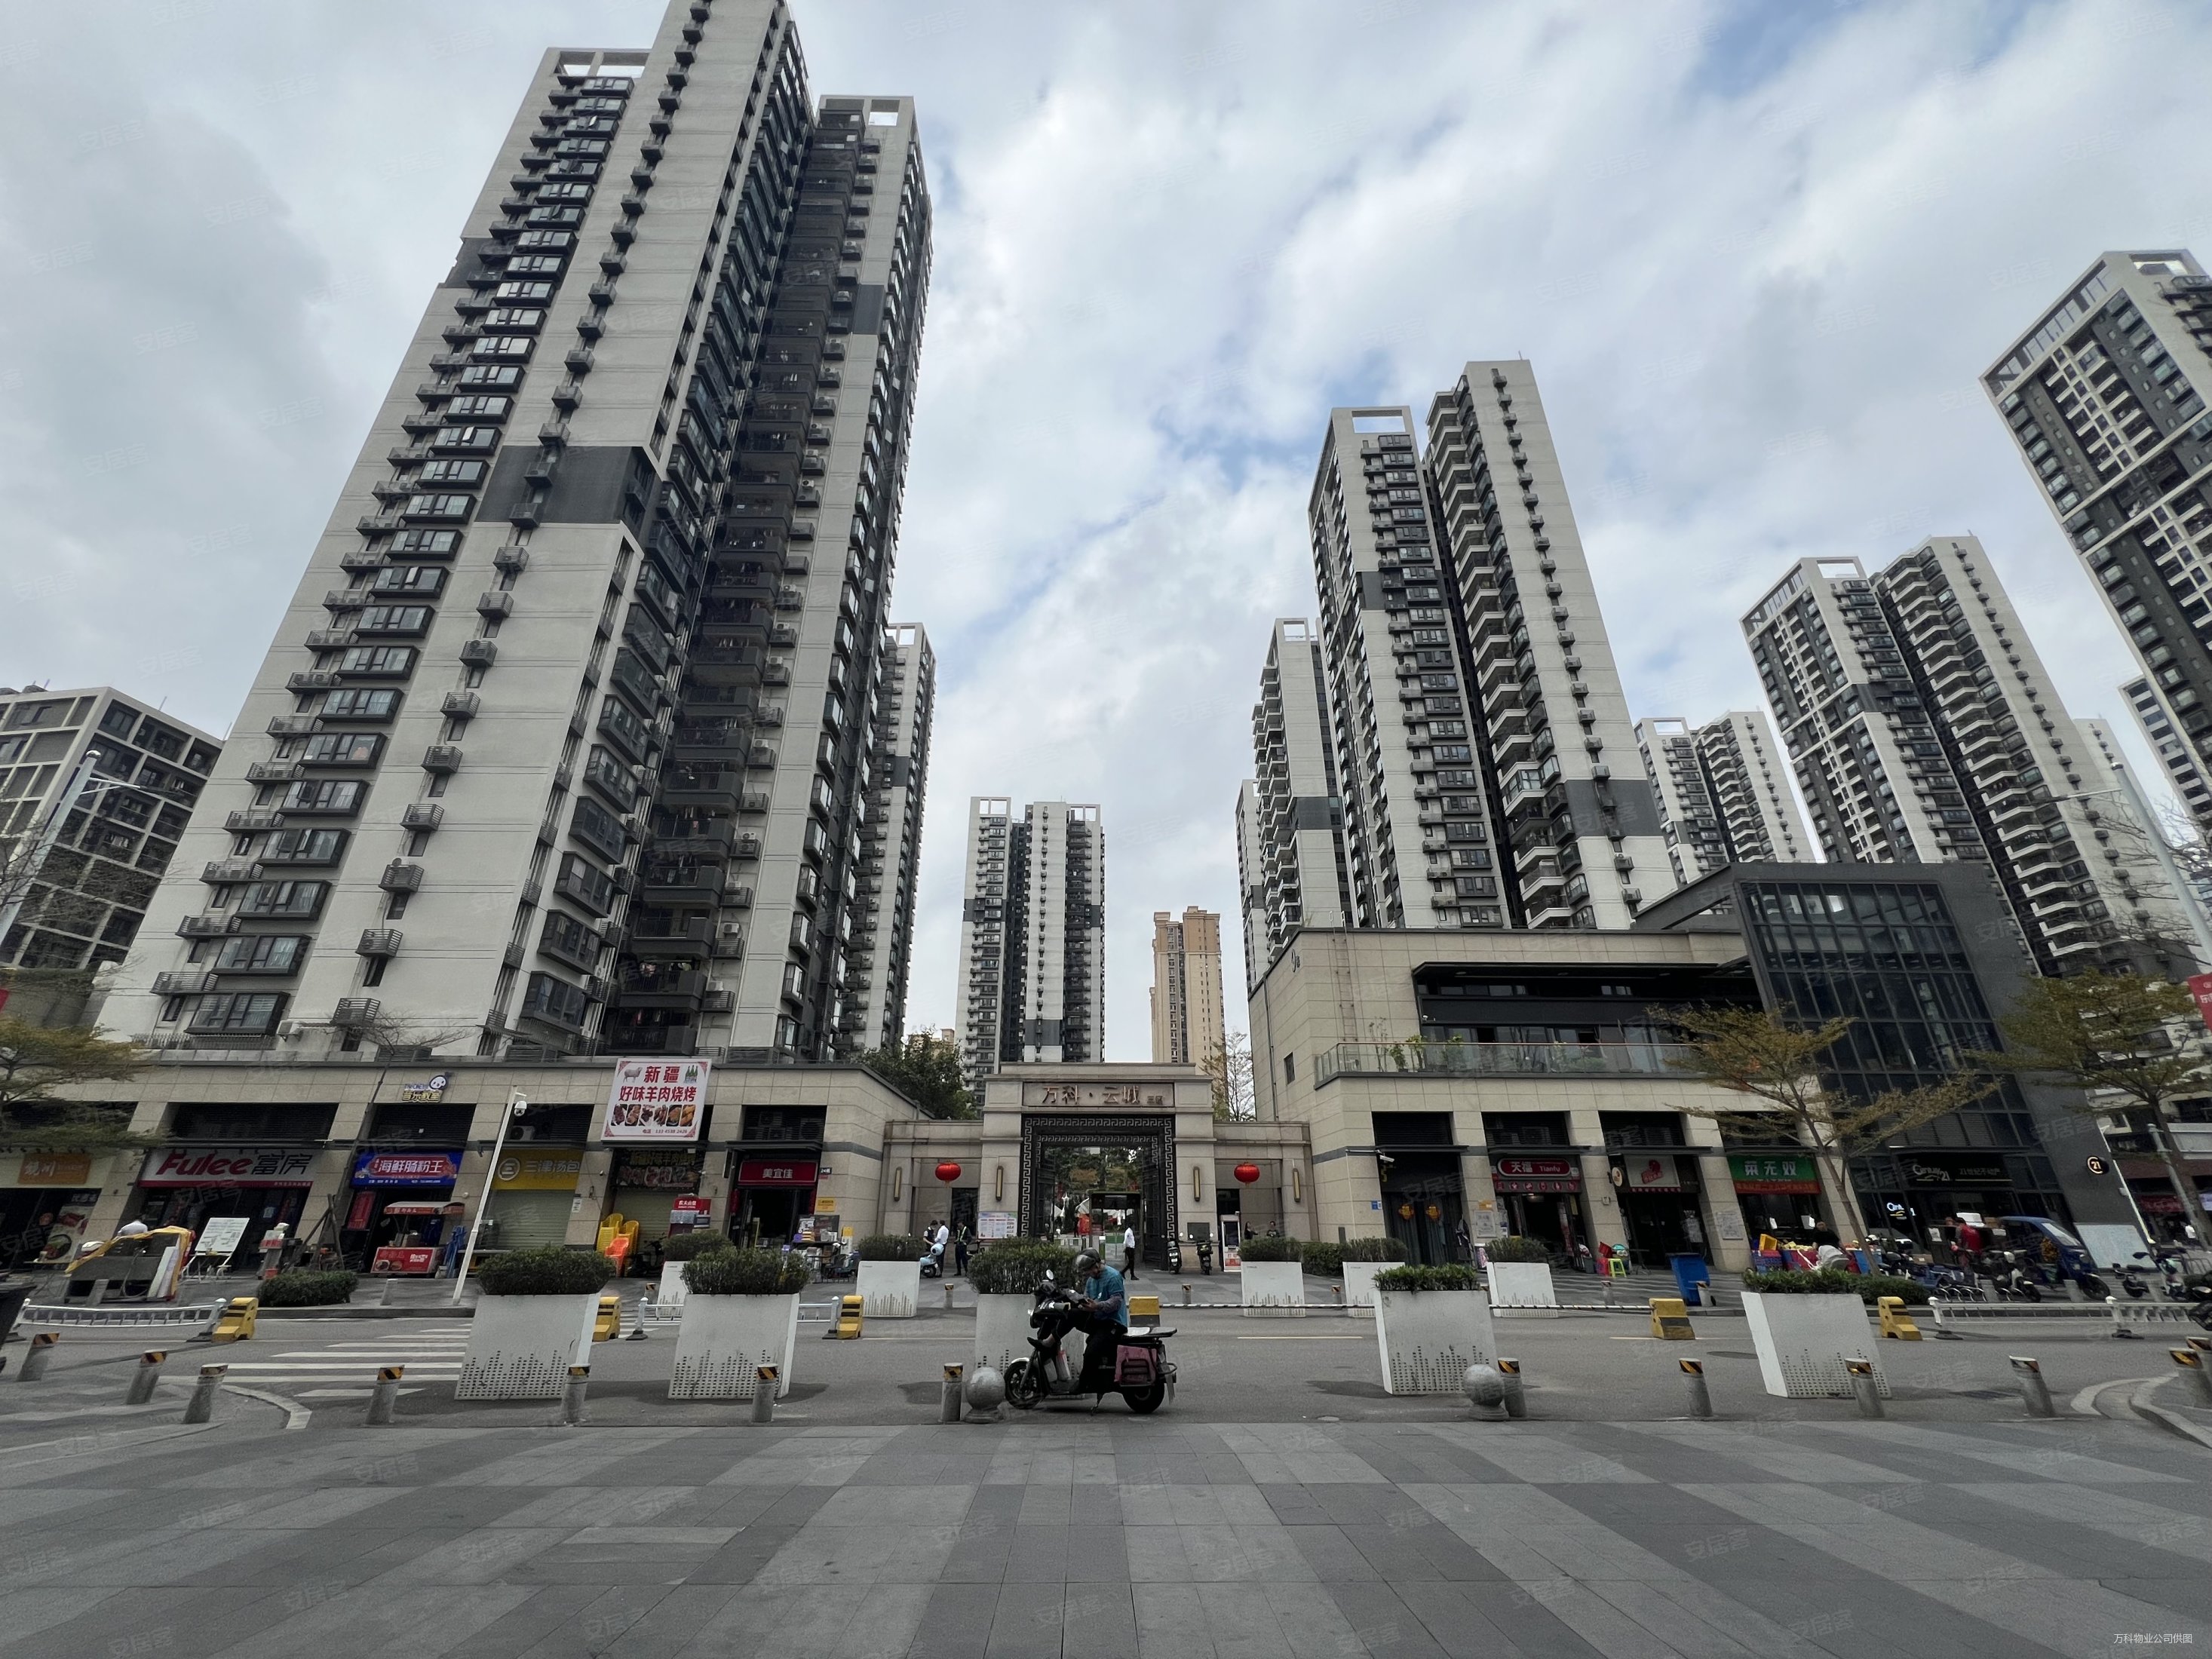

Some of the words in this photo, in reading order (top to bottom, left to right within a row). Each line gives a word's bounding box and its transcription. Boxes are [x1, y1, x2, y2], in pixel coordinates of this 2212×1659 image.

[643, 1066, 680, 1084] 新疆
[403, 1090, 442, 1102] 音乐教室
[618, 1086, 697, 1102] 好味羊肉烧烤
[155, 1151, 254, 1176] Fulee
[251, 1153, 313, 1175] 富房
[378, 1160, 443, 1173] 海鲜肠粉王
[524, 1161, 580, 1173] 三津汤包
[1511, 1161, 1533, 1173] 天福
[762, 1168, 793, 1179] 美宜佳
